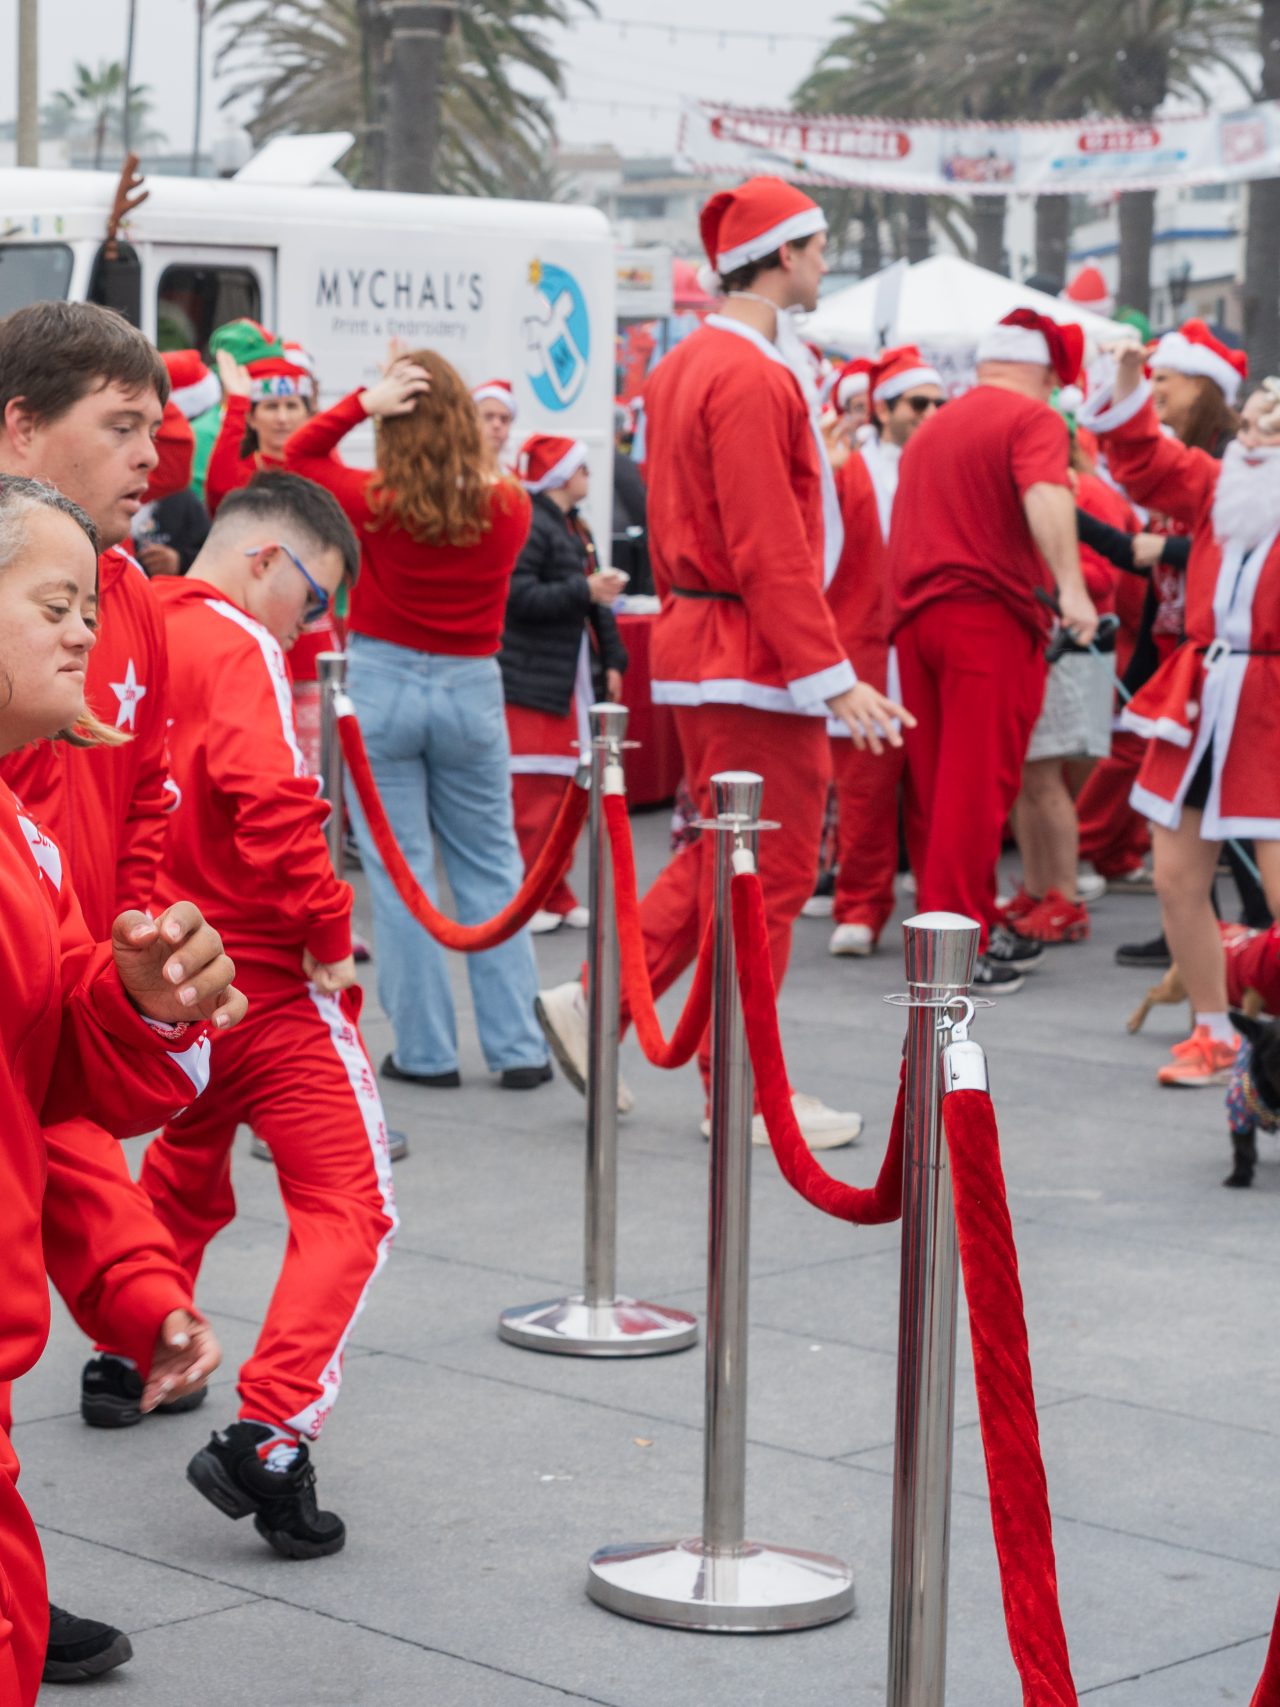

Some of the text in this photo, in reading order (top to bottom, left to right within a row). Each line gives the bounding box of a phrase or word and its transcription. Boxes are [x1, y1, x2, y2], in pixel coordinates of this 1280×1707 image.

[316, 268, 485, 311] MYCHAL'S
[332, 318, 369, 335] Print
[387, 319, 468, 339] Embroidery
